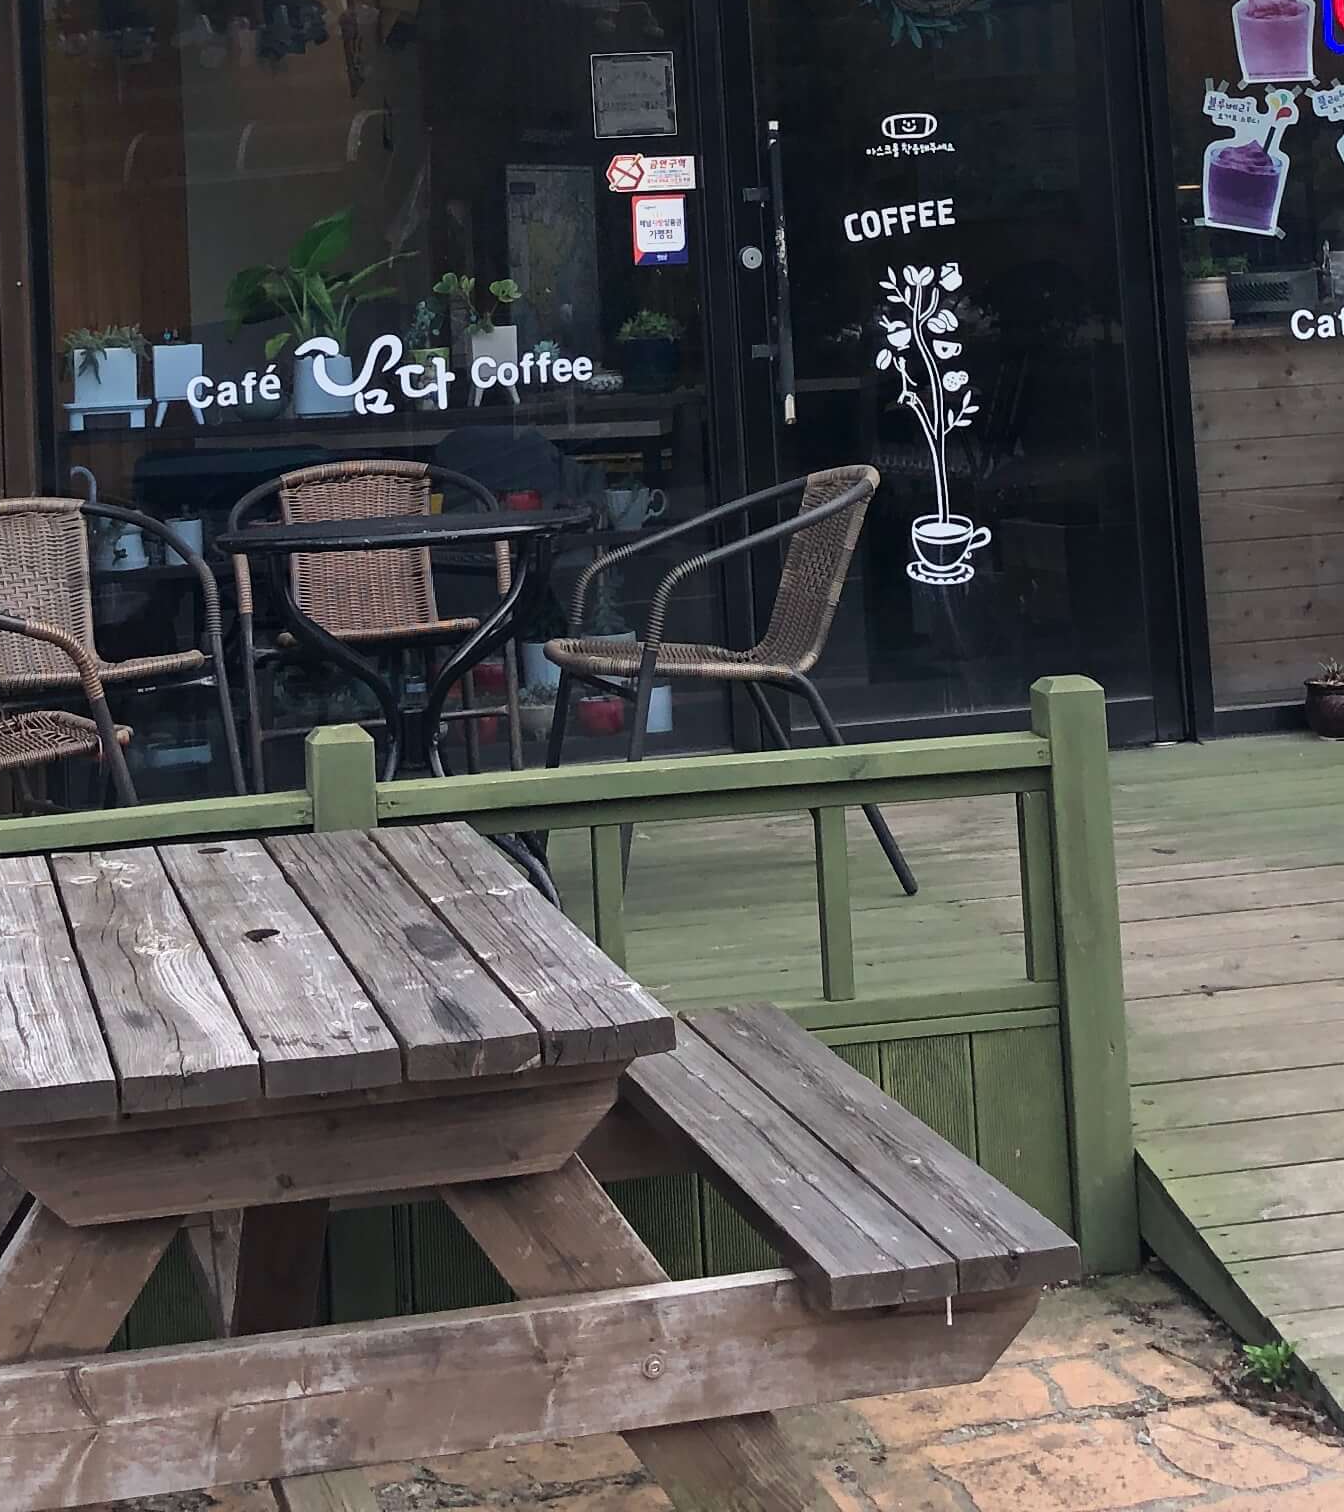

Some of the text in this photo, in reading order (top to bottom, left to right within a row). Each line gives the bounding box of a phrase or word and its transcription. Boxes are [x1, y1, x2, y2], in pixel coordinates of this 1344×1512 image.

[1208, 95, 1251, 113] 블루베리
[650, 158, 687, 169] 금연구역
[844, 198, 956, 242] COFFEE
[186, 334, 594, 415] Café 담다 Coffee
